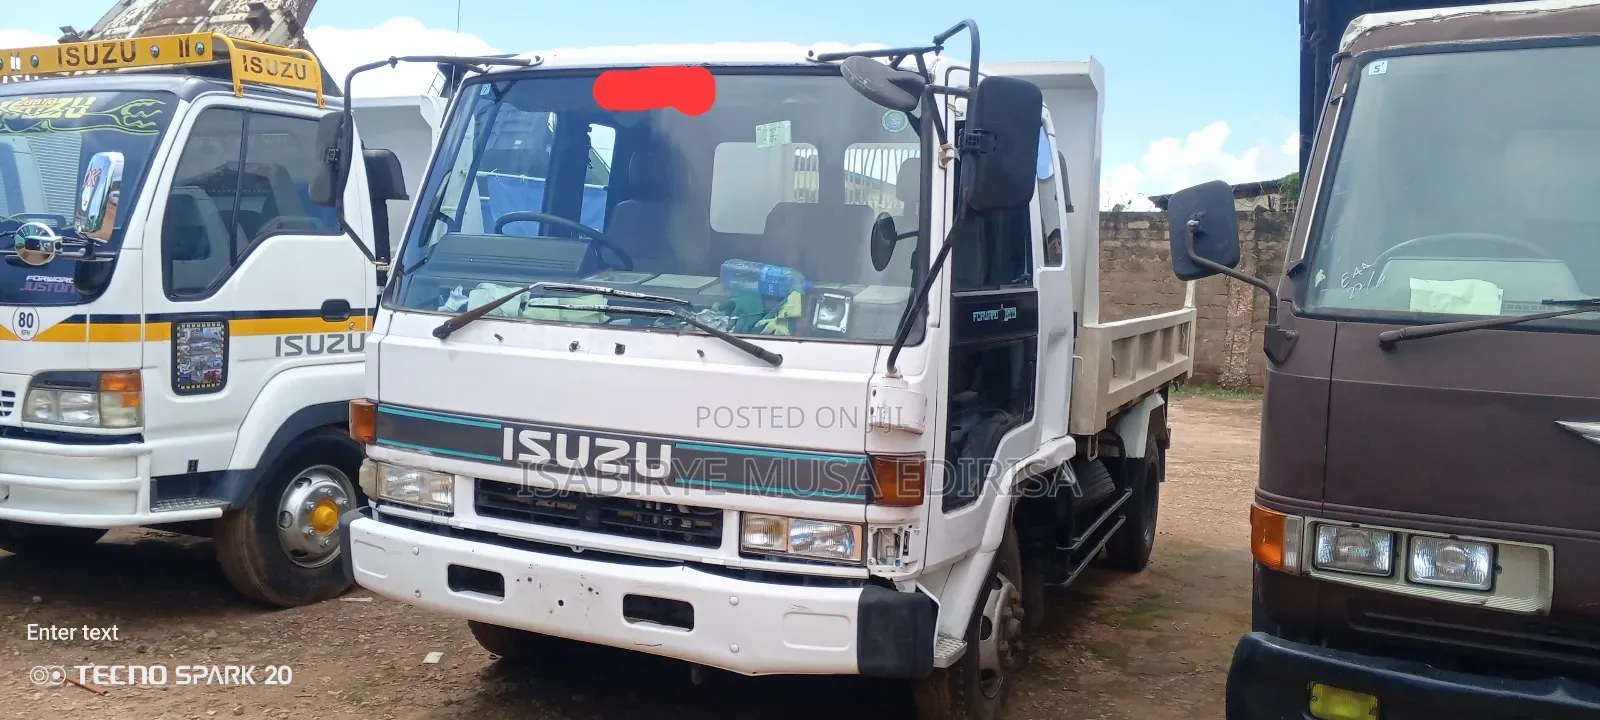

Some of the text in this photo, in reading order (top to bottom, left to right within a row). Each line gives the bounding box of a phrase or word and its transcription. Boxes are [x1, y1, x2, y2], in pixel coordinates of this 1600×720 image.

[57, 40, 136, 66] ISUZU
[243, 55, 307, 80] ISUZU
[18, 312, 34, 328] 80
[275, 332, 364, 357] ISUZU
[502, 428, 671, 479] ISUZU
